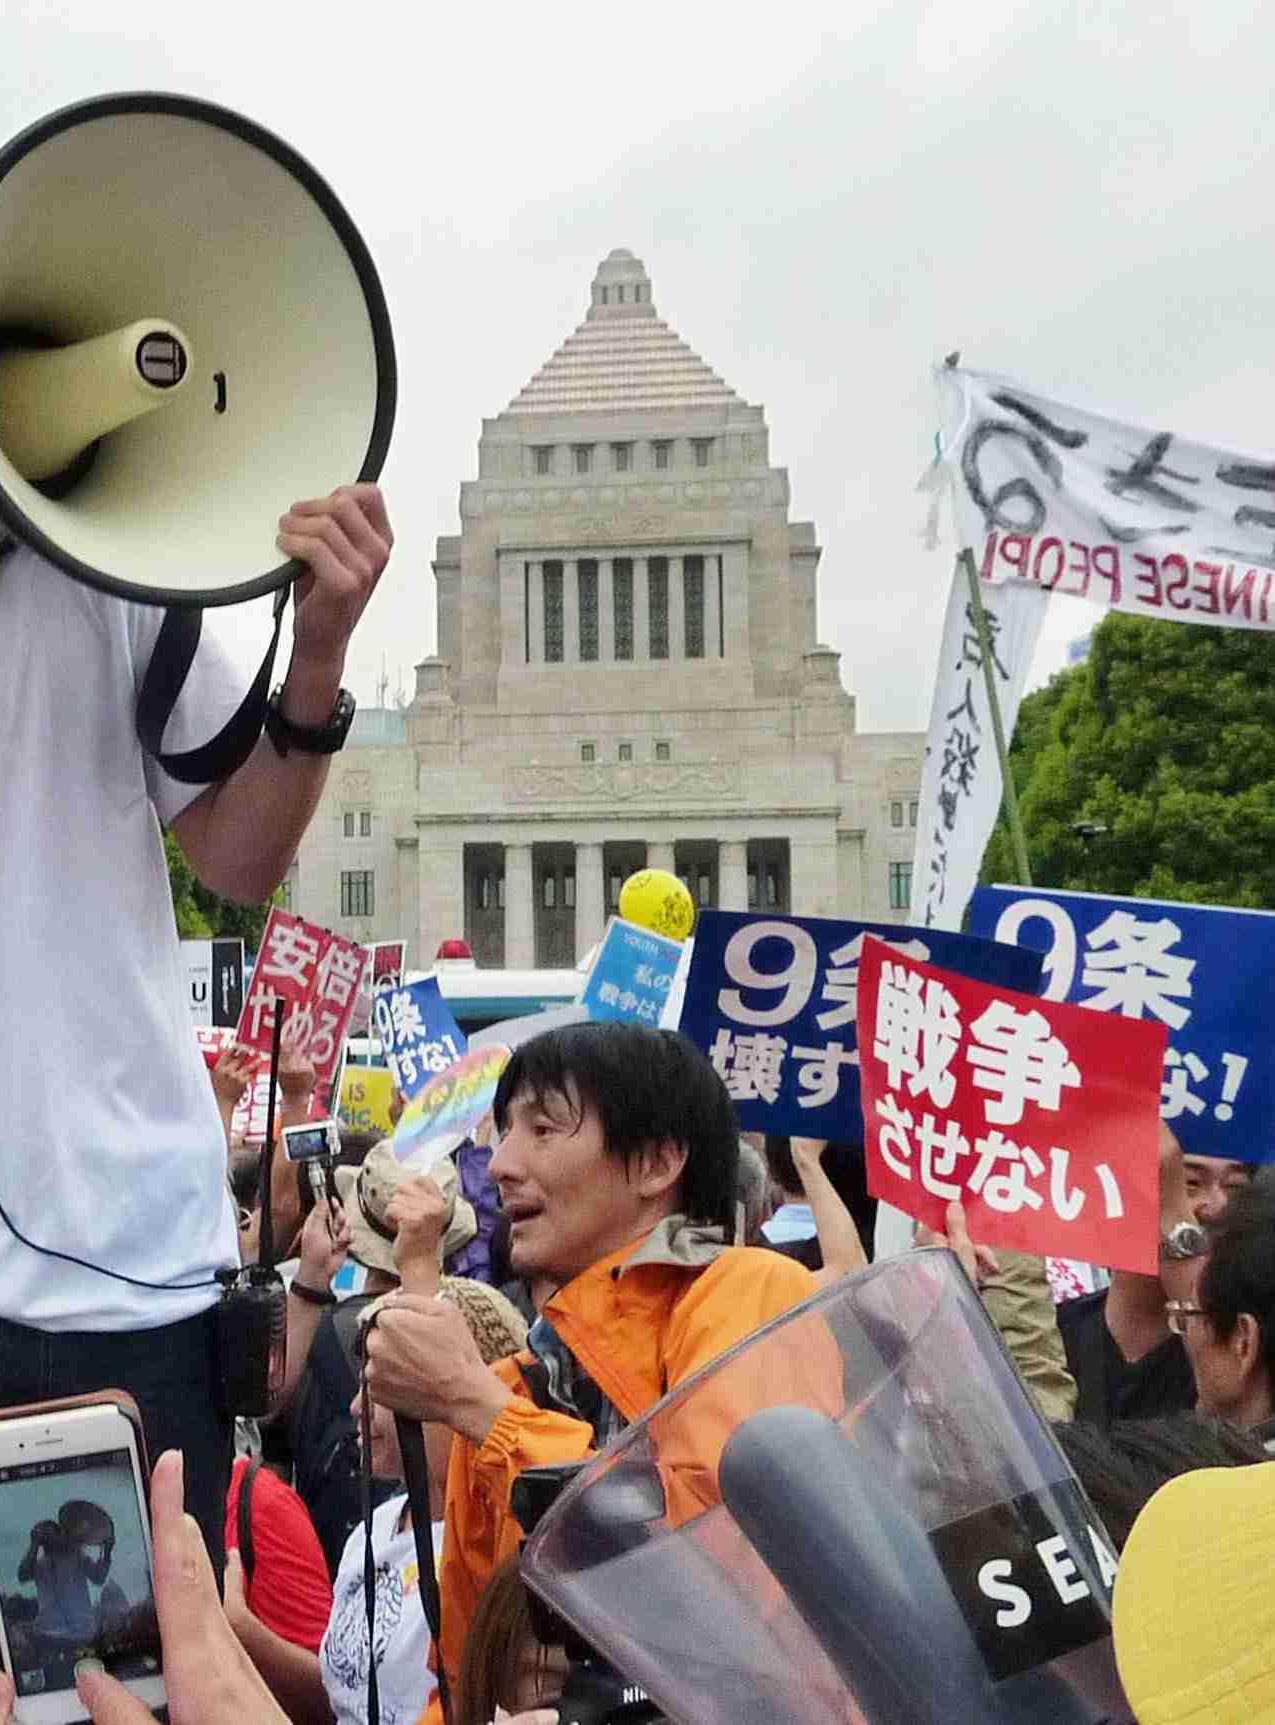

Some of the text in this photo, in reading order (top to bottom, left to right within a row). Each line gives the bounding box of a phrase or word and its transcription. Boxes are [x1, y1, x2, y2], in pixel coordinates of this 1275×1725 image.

[994, 899, 1196, 1031] 9条
[709, 1028, 860, 1108] 壊す
[874, 960, 1082, 1125] 戦争
[875, 1093, 1125, 1221] させない
